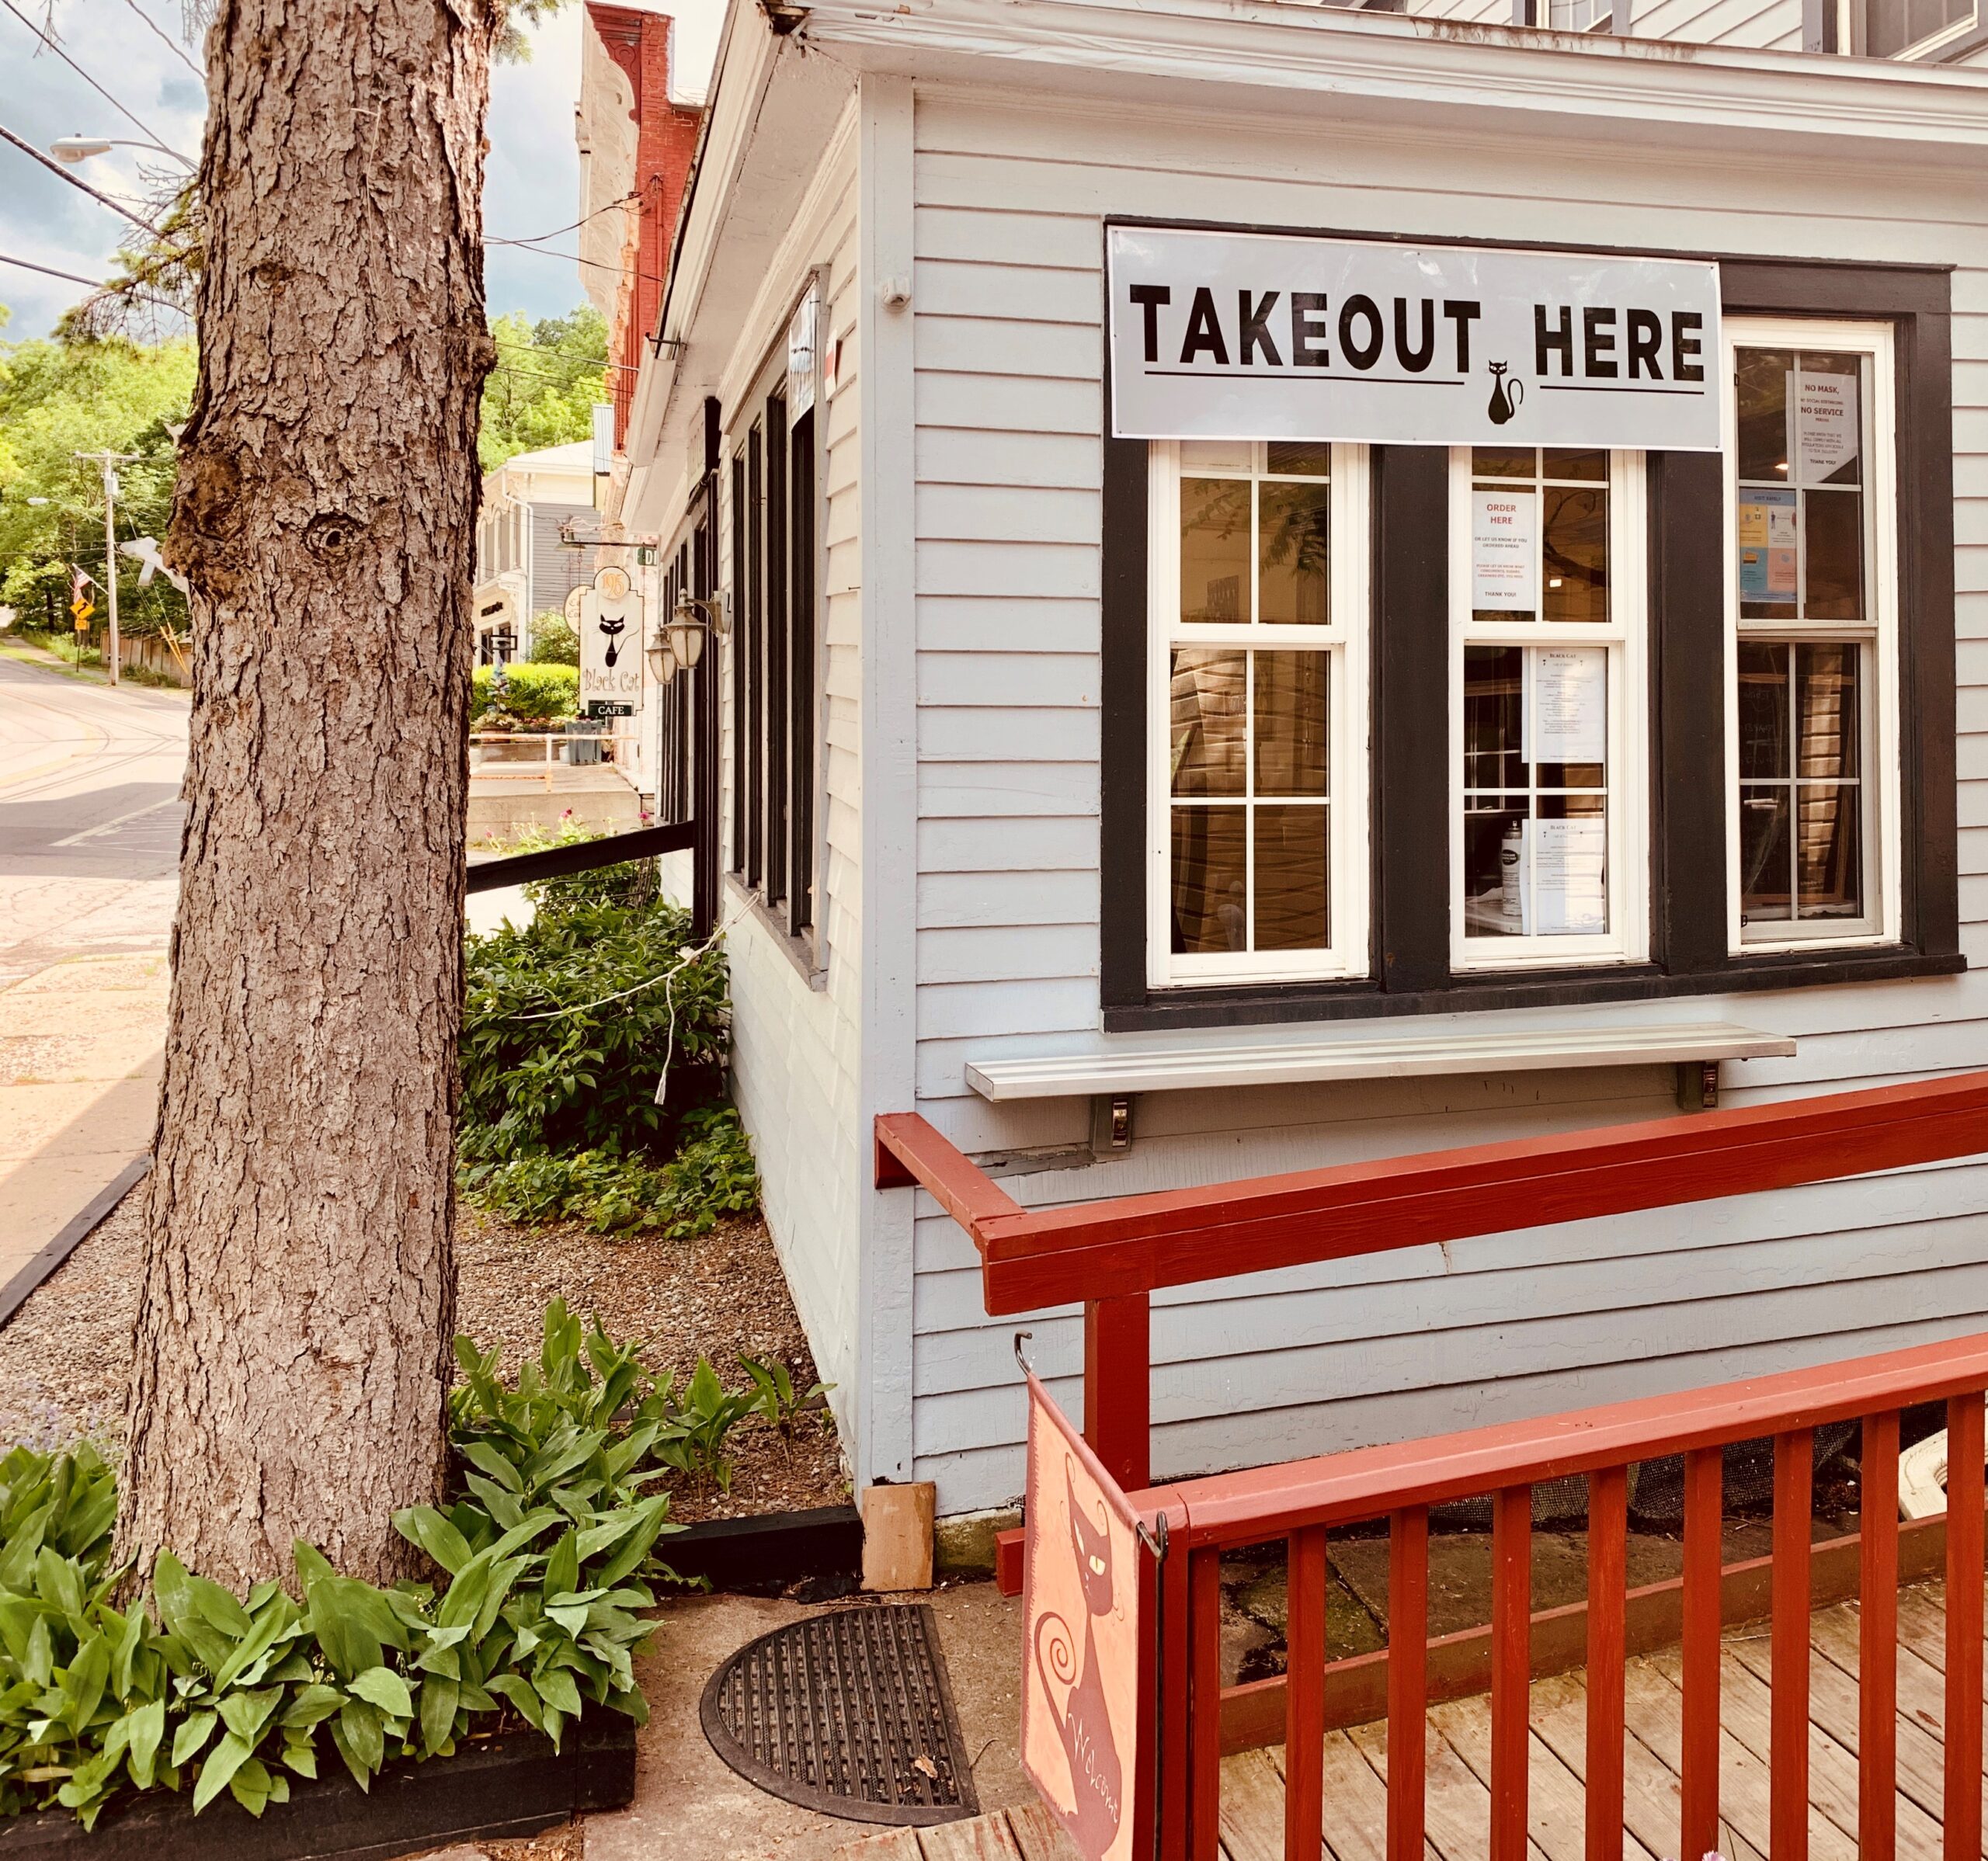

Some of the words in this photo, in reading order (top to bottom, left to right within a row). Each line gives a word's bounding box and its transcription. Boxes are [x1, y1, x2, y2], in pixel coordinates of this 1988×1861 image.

[1130, 283, 1481, 373] TAKEOUT
[1534, 304, 1705, 382] HERE
[1818, 385, 1840, 395] MASK,
[1814, 408, 1844, 416] SERVICE
[1486, 504, 1517, 512] ORDER
[1490, 516, 1513, 525] HERE
[601, 572, 625, 598] 195
[582, 668, 615, 692] Black
[620, 671, 640, 693] Cat
[598, 706, 624, 715] CAFE
[1067, 1712, 1118, 1824] Welcome
